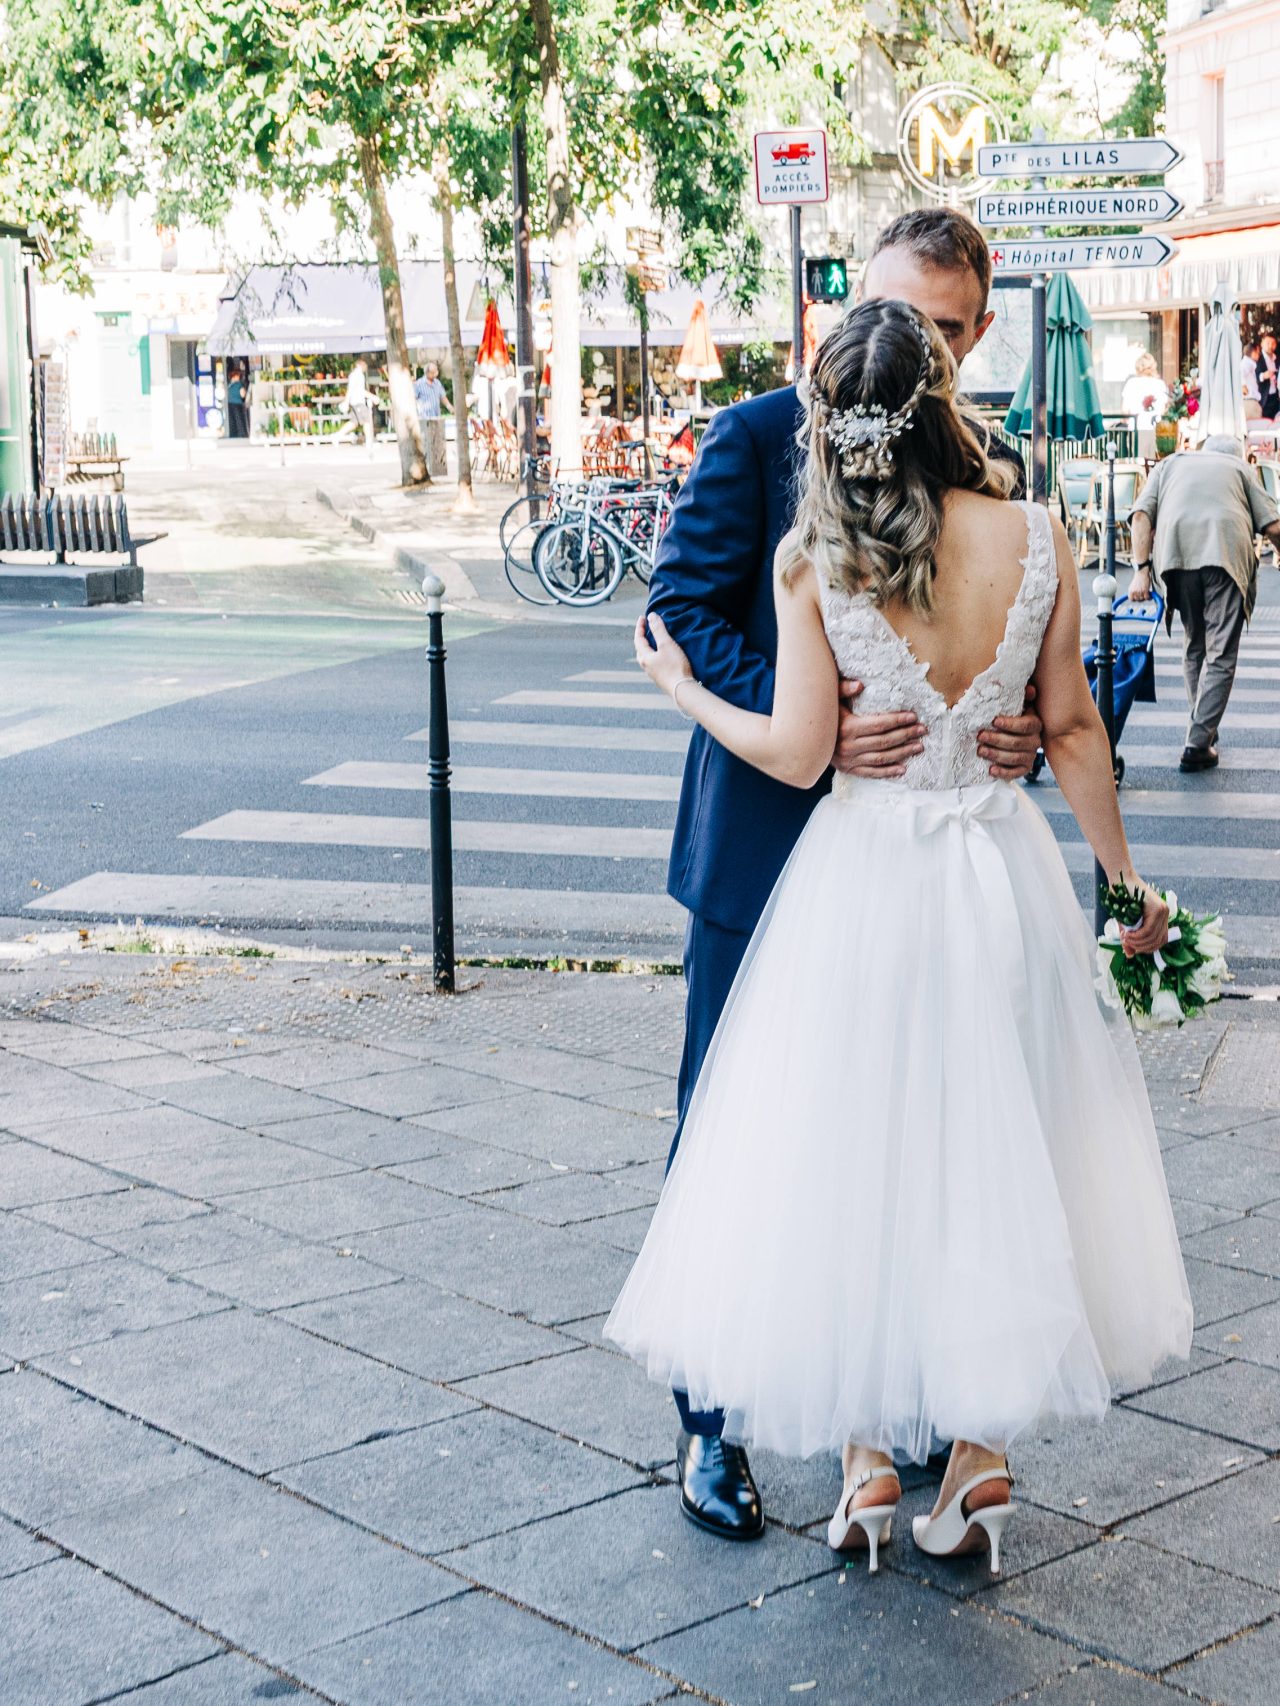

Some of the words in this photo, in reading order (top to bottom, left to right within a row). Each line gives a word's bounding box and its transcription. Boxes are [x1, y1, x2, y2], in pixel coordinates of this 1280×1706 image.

[1027, 157, 1051, 167] DES
[1062, 150, 1119, 166] LILAS
[764, 183, 821, 194] POMPIERS
[986, 197, 1108, 216] PÉRIPHÉRIQUE
[1113, 198, 1159, 213] NORD
[1011, 248, 1074, 268] Hôpital
[1086, 245, 1144, 262] TENON
